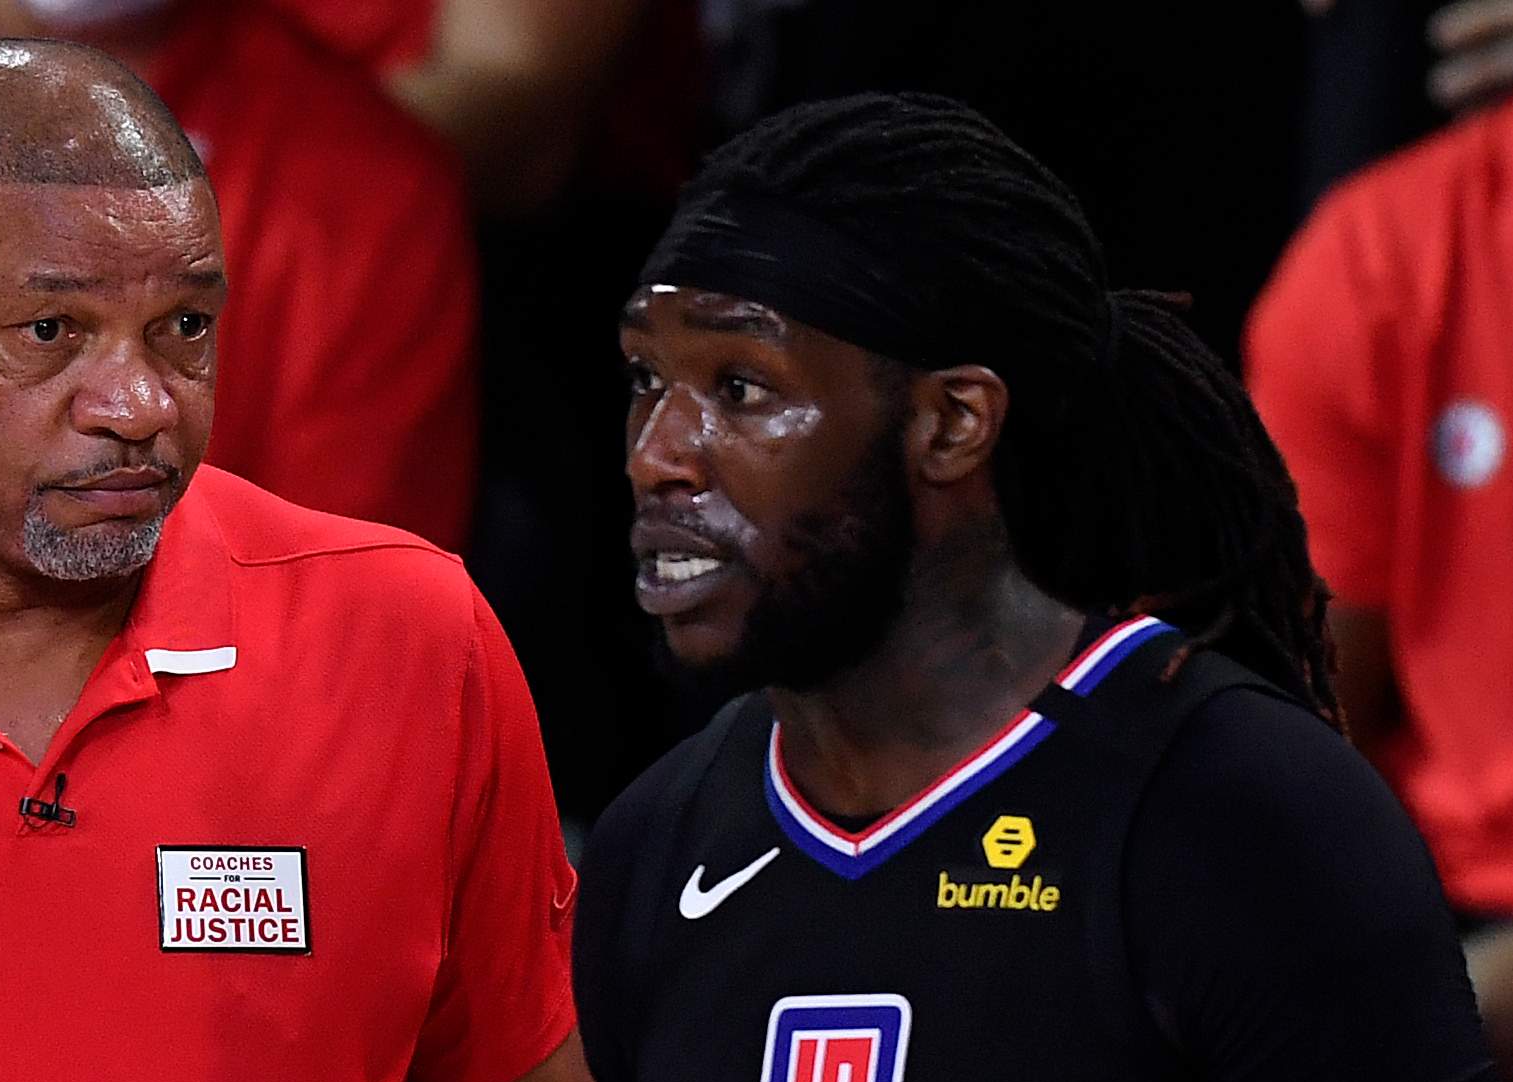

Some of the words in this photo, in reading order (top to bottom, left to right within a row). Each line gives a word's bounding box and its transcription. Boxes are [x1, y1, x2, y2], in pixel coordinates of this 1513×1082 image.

[190, 856, 274, 871] COACHES
[224, 874, 241, 883] FOR
[936, 870, 1061, 912] bumble
[176, 887, 293, 913] RACIAL
[170, 917, 300, 943] JUSTICE
